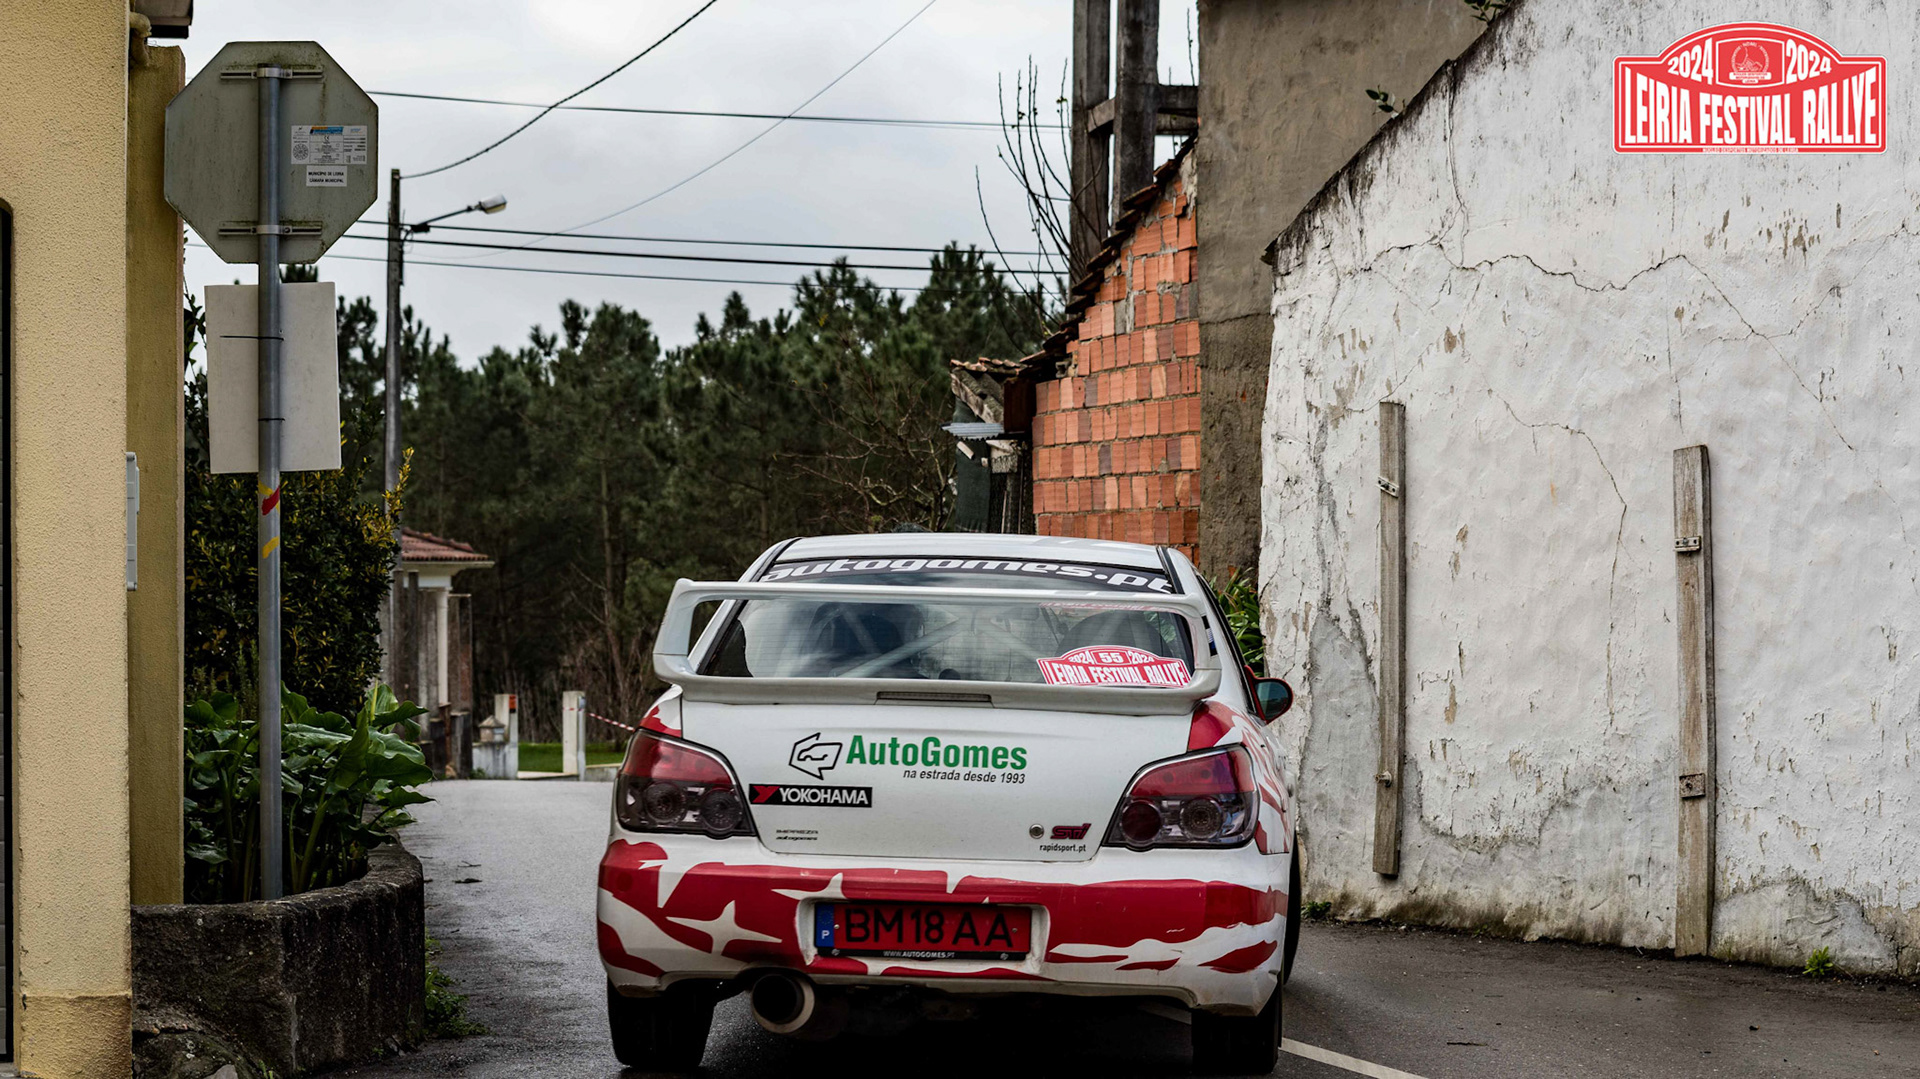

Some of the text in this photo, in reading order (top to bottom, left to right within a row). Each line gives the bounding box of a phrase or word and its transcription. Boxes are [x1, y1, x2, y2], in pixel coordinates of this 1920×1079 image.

[761, 558, 1173, 595] autogomes.pt
[1068, 650, 1155, 665] 2024 55 2024
[1044, 660, 1190, 687] LEIRIA FESTIVAL RALLYE
[845, 734, 1027, 771] AutoGomes
[903, 768, 1026, 784] na estrada desde 1993
[779, 786, 869, 806] YOKOHAMA
[1040, 843, 1087, 853] rapidsport.pt
[820, 929, 830, 940] P
[883, 950, 956, 958] WWW.AUTOGOMES.PT
